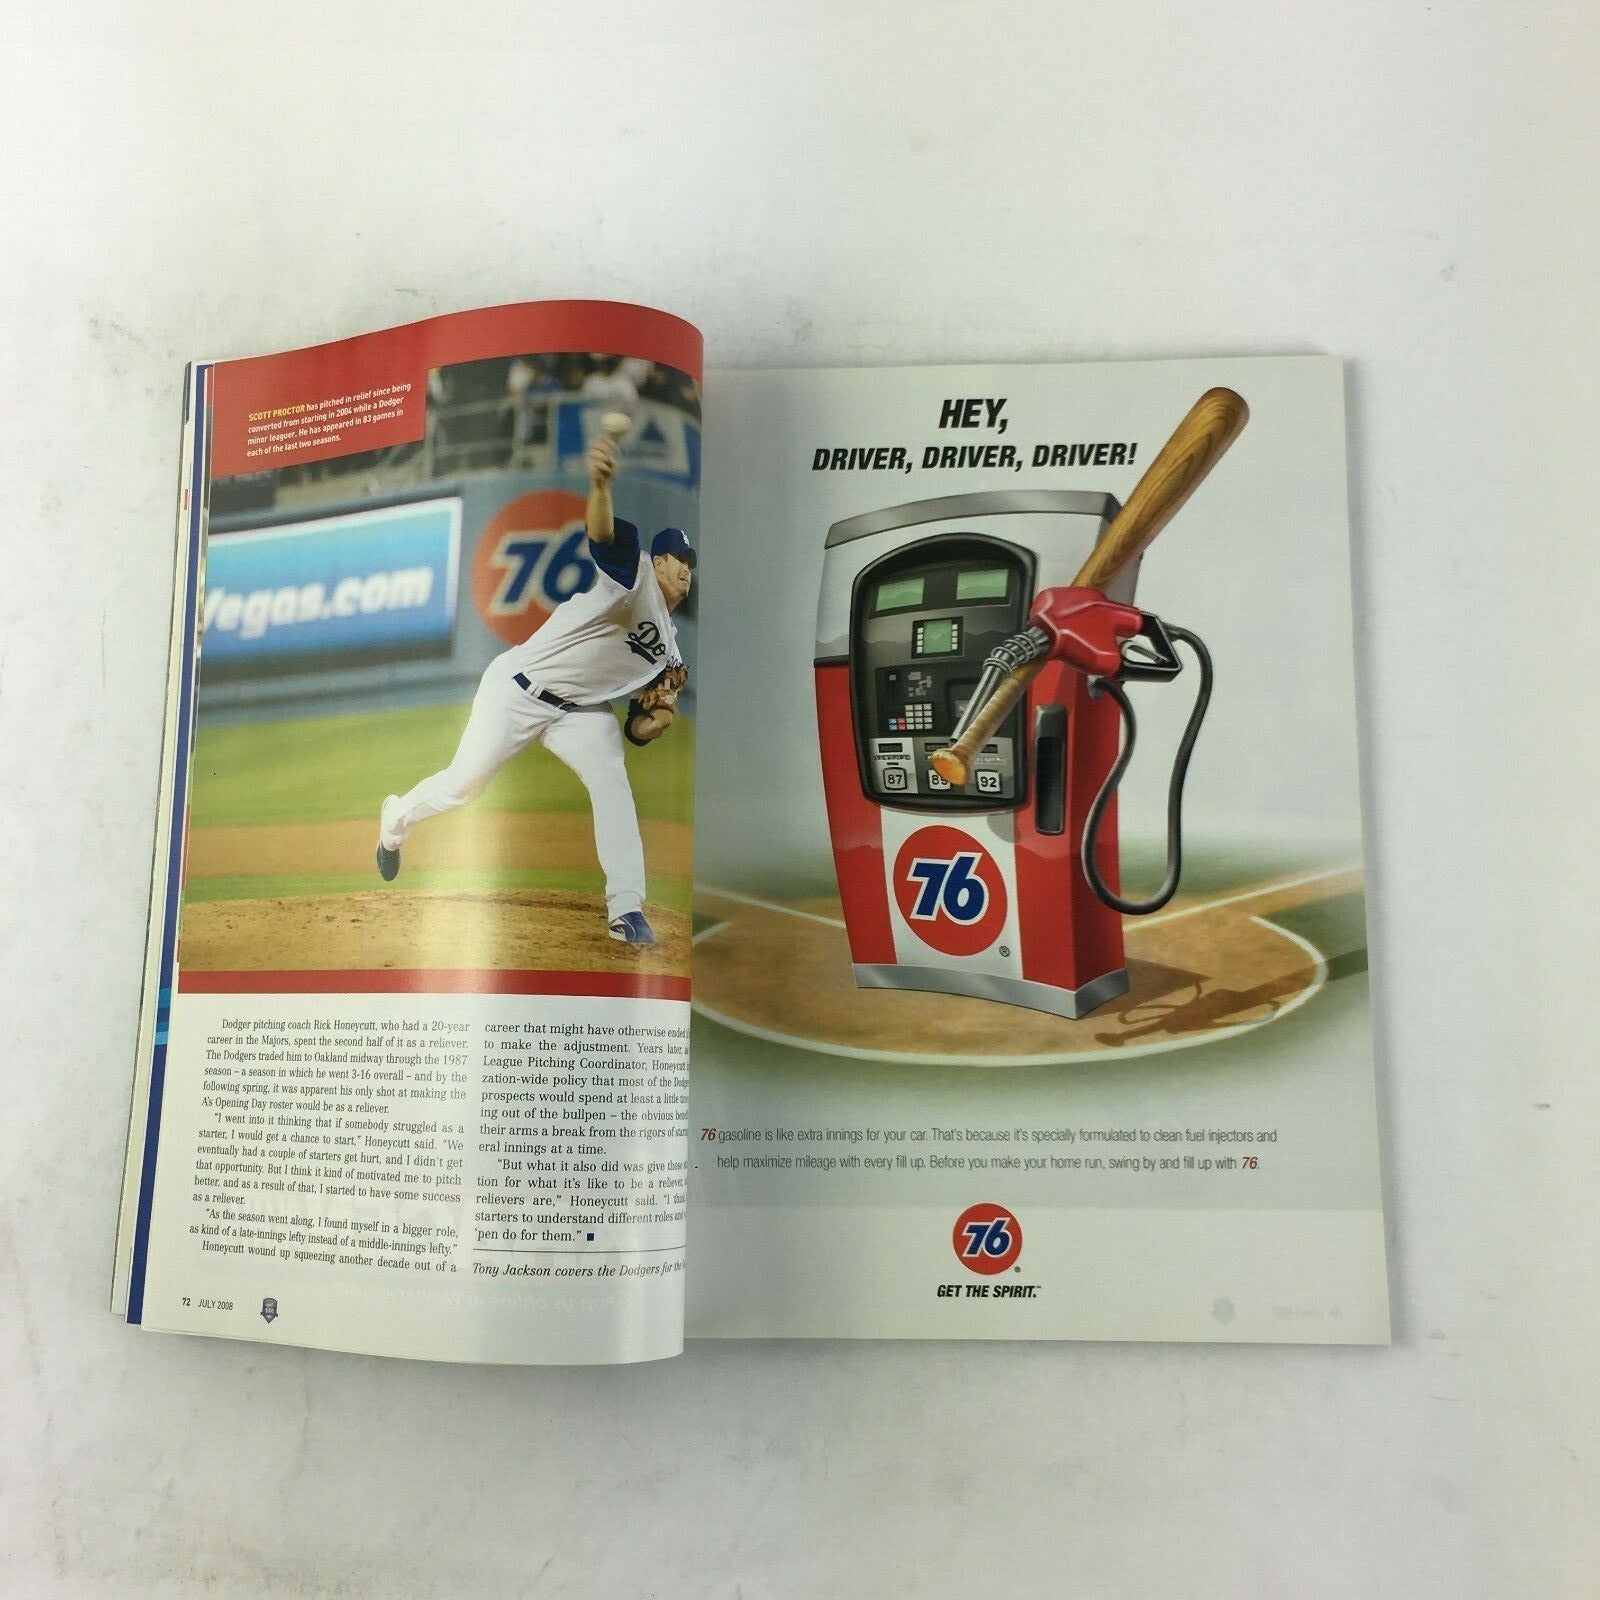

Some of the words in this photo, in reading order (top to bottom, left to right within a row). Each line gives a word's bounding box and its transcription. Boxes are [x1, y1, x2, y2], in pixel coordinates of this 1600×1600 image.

[248, 410, 271, 421] SCOTT
[272, 404, 305, 416] PROCTOR
[319, 396, 344, 409] pitched
[352, 390, 371, 400] relief
[372, 388, 390, 397] since
[391, 383, 411, 392] being
[247, 421, 281, 432] converted
[283, 419, 299, 427] from
[300, 413, 326, 424] starting
[336, 406, 352, 416] 2004
[353, 403, 371, 412] while
[378, 397, 404, 407] Dodger
[938, 398, 1009, 434] HEY,
[247, 436, 268, 444] minor
[269, 431, 297, 441] leaguer.
[298, 428, 308, 436] He
[308, 426, 321, 434] has
[322, 418, 353, 432] appeared
[362, 414, 371, 423] 83
[372, 411, 395, 423] games
[396, 408, 403, 416] in
[246, 447, 262, 456] each
[264, 445, 271, 454] of
[272, 444, 283, 452] the
[284, 441, 297, 450] last
[298, 440, 311, 448] two
[312, 434, 341, 445] seasons.
[811, 447, 913, 474] DRIVER,
[921, 445, 1023, 472] DRIVER,
[1031, 442, 1137, 467] DRIVER!
[493, 522, 599, 612] 76
[887, 774, 903, 785] 87
[980, 776, 997, 788] 92
[906, 852, 990, 925] 76
[221, 1018, 251, 1031] Dodger
[253, 1019, 285, 1031] pitching
[287, 1019, 310, 1029] coach
[313, 1019, 331, 1029] Rick
[333, 1019, 377, 1032] Honeycutt,
[380, 1020, 399, 1030] who
[402, 1020, 419, 1030] had
[431, 1020, 470, 1033] 20-year
[484, 1024, 520, 1032] career
[523, 1022, 546, 1033] that
[549, 1023, 583, 1036] might
[586, 1023, 614, 1034] have
[617, 1025, 665, 1036] otherwise
[206, 1036, 232, 1044] career
[235, 1036, 242, 1044] in
[246, 1034, 258, 1044] the
[261, 1035, 290, 1047] Majors,
[293, 1037, 316, 1047] spent
[318, 1035, 331, 1045] the
[334, 1036, 362, 1046] second
[365, 1036, 384, 1046] half
[385, 1036, 395, 1046] of
[396, 1037, 403, 1047] it
[406, 1039, 416, 1047] as
[419, 1039, 425, 1047] a
[428, 1038, 468, 1047] reliever.
[484, 1040, 494, 1048] to
[500, 1039, 531, 1049] make
[538, 1039, 556, 1050] the
[563, 1040, 630, 1053] adjustment.
[637, 1042, 662, 1053] Years
[205, 1049, 221, 1059] The
[223, 1049, 256, 1062] Dodgers
[258, 1050, 284, 1060] traded
[286, 1051, 301, 1061] him
[304, 1053, 312, 1061] to
[314, 1051, 347, 1062] Oakland
[349, 1052, 383, 1065] midway
[386, 1053, 421, 1066] through
[424, 1054, 439, 1064] the
[443, 1054, 467, 1064] 1987
[483, 1055, 522, 1068] League
[527, 1056, 575, 1070] Pitching
[579, 1057, 647, 1069] Coordinator,
[482, 1073, 548, 1084] zation-wide
[552, 1074, 587, 1087] policy
[591, 1074, 614, 1085] that
[618, 1078, 644, 1086] most
[647, 1076, 657, 1086] of
[659, 1076, 671, 1087] the
[700, 1128, 716, 1140] 76
[718, 1128, 761, 1143] gasoline
[764, 1128, 773, 1140] is
[776, 1128, 793, 1140] like
[797, 1128, 822, 1140] extra
[826, 1128, 863, 1143] innings
[866, 1127, 881, 1140] for
[883, 1130, 906, 1143] your
[909, 1130, 927, 1140] car.
[930, 1127, 962, 1140] That's
[965, 1129, 1010, 1141] because
[1013, 1128, 1028, 1141] it's
[1031, 1128, 1075, 1143] specially
[1079, 1128, 1136, 1141] formulated
[1139, 1130, 1150, 1141] to
[1153, 1129, 1182, 1141] clean
[1185, 1128, 1204, 1141] fuel
[1208, 1128, 1253, 1143] injectors
[1256, 1129, 1277, 1142] and
[478, 1140, 499, 1151] eral
[504, 1142, 546, 1155] innings
[550, 1144, 562, 1153] at
[566, 1145, 573, 1153] a
[577, 1144, 606, 1154] time.
[717, 1155, 739, 1169] help
[743, 1155, 791, 1167] maximize
[795, 1155, 836, 1170] mileage
[839, 1155, 860, 1167] with
[863, 1157, 892, 1169] every
[895, 1154, 906, 1167] fill
[910, 1157, 925, 1170] up.
[929, 1154, 965, 1168] Before
[967, 1157, 987, 1170] you
[990, 1155, 1021, 1168] make
[1023, 1158, 1046, 1170] your
[1050, 1156, 1081, 1168] home
[1084, 1158, 1105, 1169] run,
[1108, 1156, 1139, 1171] swing
[1142, 1156, 1156, 1171] by
[1159, 1156, 1179, 1169] and
[1183, 1155, 1194, 1168] fill
[1197, 1158, 1212, 1171] up
[1214, 1156, 1237, 1169] with
[1241, 1156, 1259, 1169] 76.
[962, 1217, 1012, 1258] 76
[473, 1262, 499, 1277] Tony
[502, 1264, 550, 1275] Jackson
[554, 1268, 593, 1276] covers
[597, 1264, 615, 1276] the
[619, 1265, 659, 1276] Dodgers
[661, 1262, 674, 1275] for
[937, 1285, 962, 1298] GET
[965, 1285, 990, 1298] THE
[182, 1298, 191, 1307] 72
[197, 1299, 216, 1309] JULY
[216, 1300, 233, 1311] 2008
